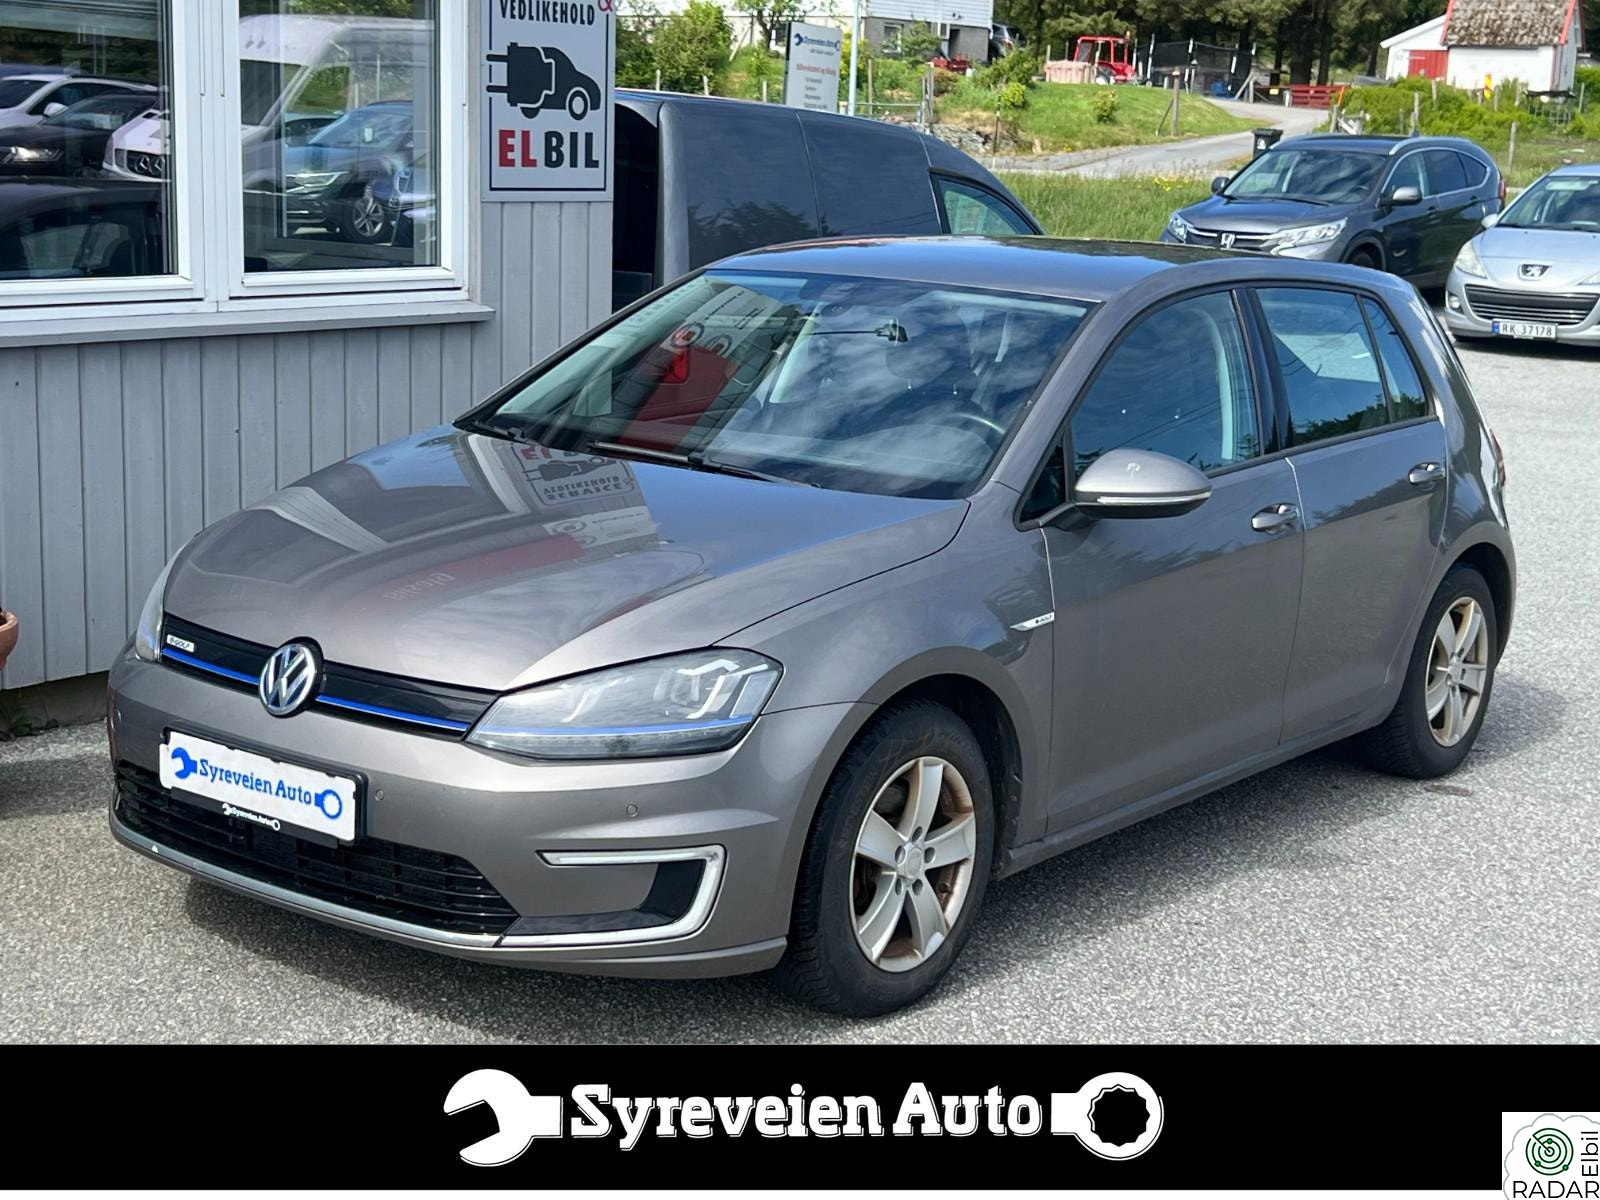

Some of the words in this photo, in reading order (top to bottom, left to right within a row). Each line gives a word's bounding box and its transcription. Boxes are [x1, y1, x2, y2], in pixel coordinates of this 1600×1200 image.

[500, 0, 595, 26] VEDLIKEHOLD
[1502, 323, 1516, 335] RK
[1521, 325, 1553, 337] 37178
[199, 758, 273, 796] Syreveien
[275, 779, 313, 806] Auto
